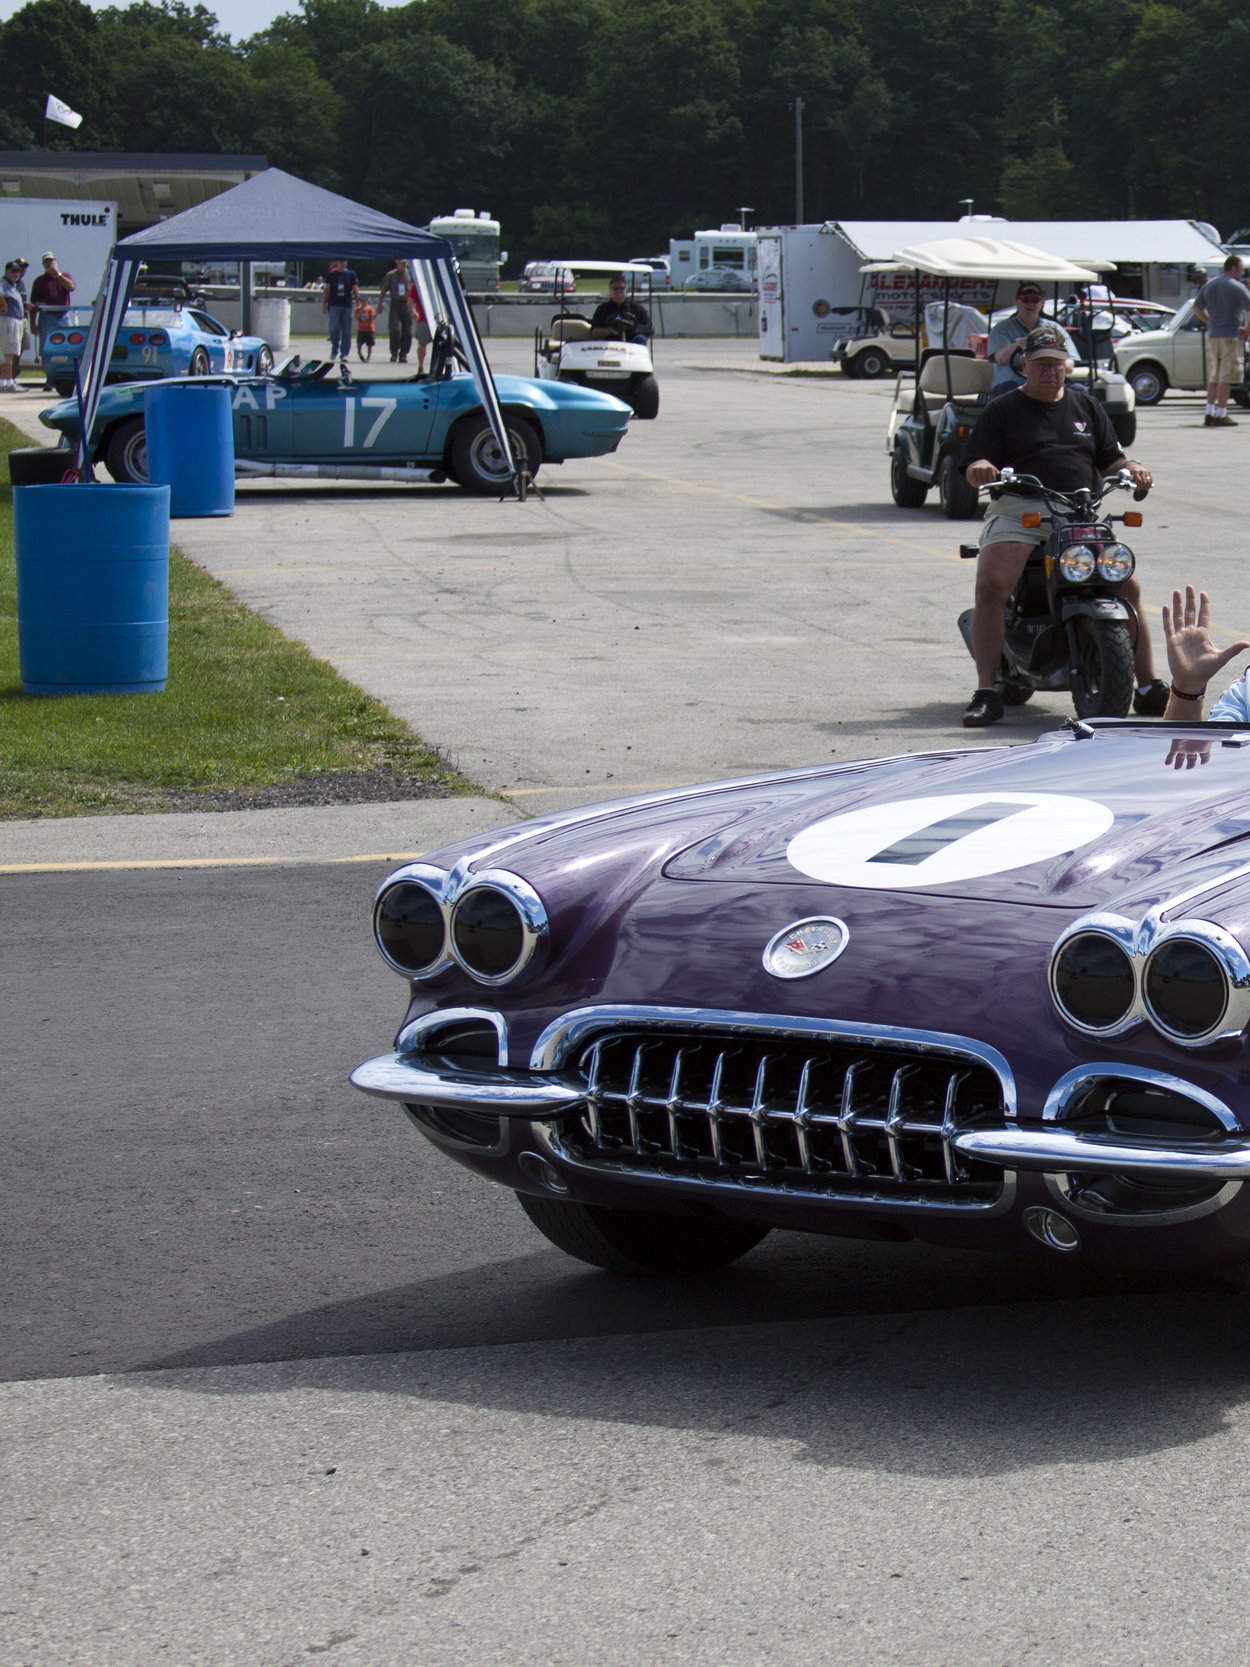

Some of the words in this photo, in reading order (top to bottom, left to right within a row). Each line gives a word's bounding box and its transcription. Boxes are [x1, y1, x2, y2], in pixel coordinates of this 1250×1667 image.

[60, 213, 107, 226] THULE
[141, 346, 157, 364] 91
[343, 397, 397, 448] 17
[865, 801, 1039, 866] 1
